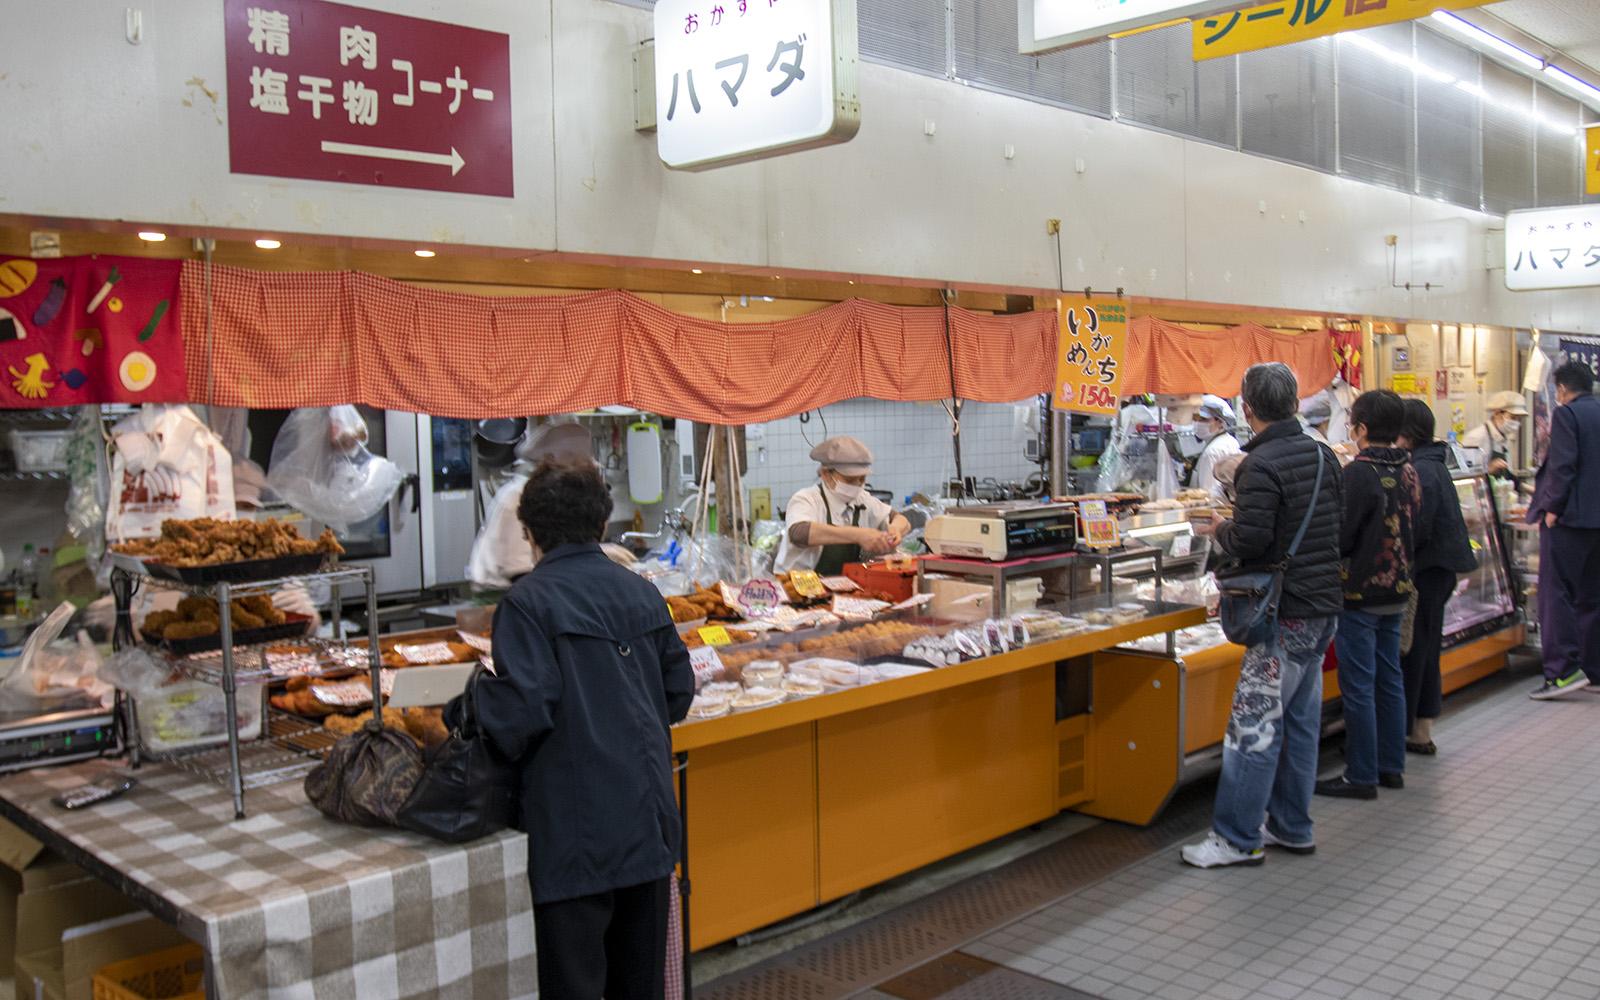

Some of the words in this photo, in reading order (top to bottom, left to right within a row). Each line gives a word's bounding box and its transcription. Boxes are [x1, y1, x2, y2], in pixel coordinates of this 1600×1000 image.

[247, 7, 377, 70] 精肉
[684, 0, 778, 34] おかず
[249, 66, 379, 126] 塩干物
[392, 58, 494, 115] コーナー
[667, 33, 807, 121] ハマダ
